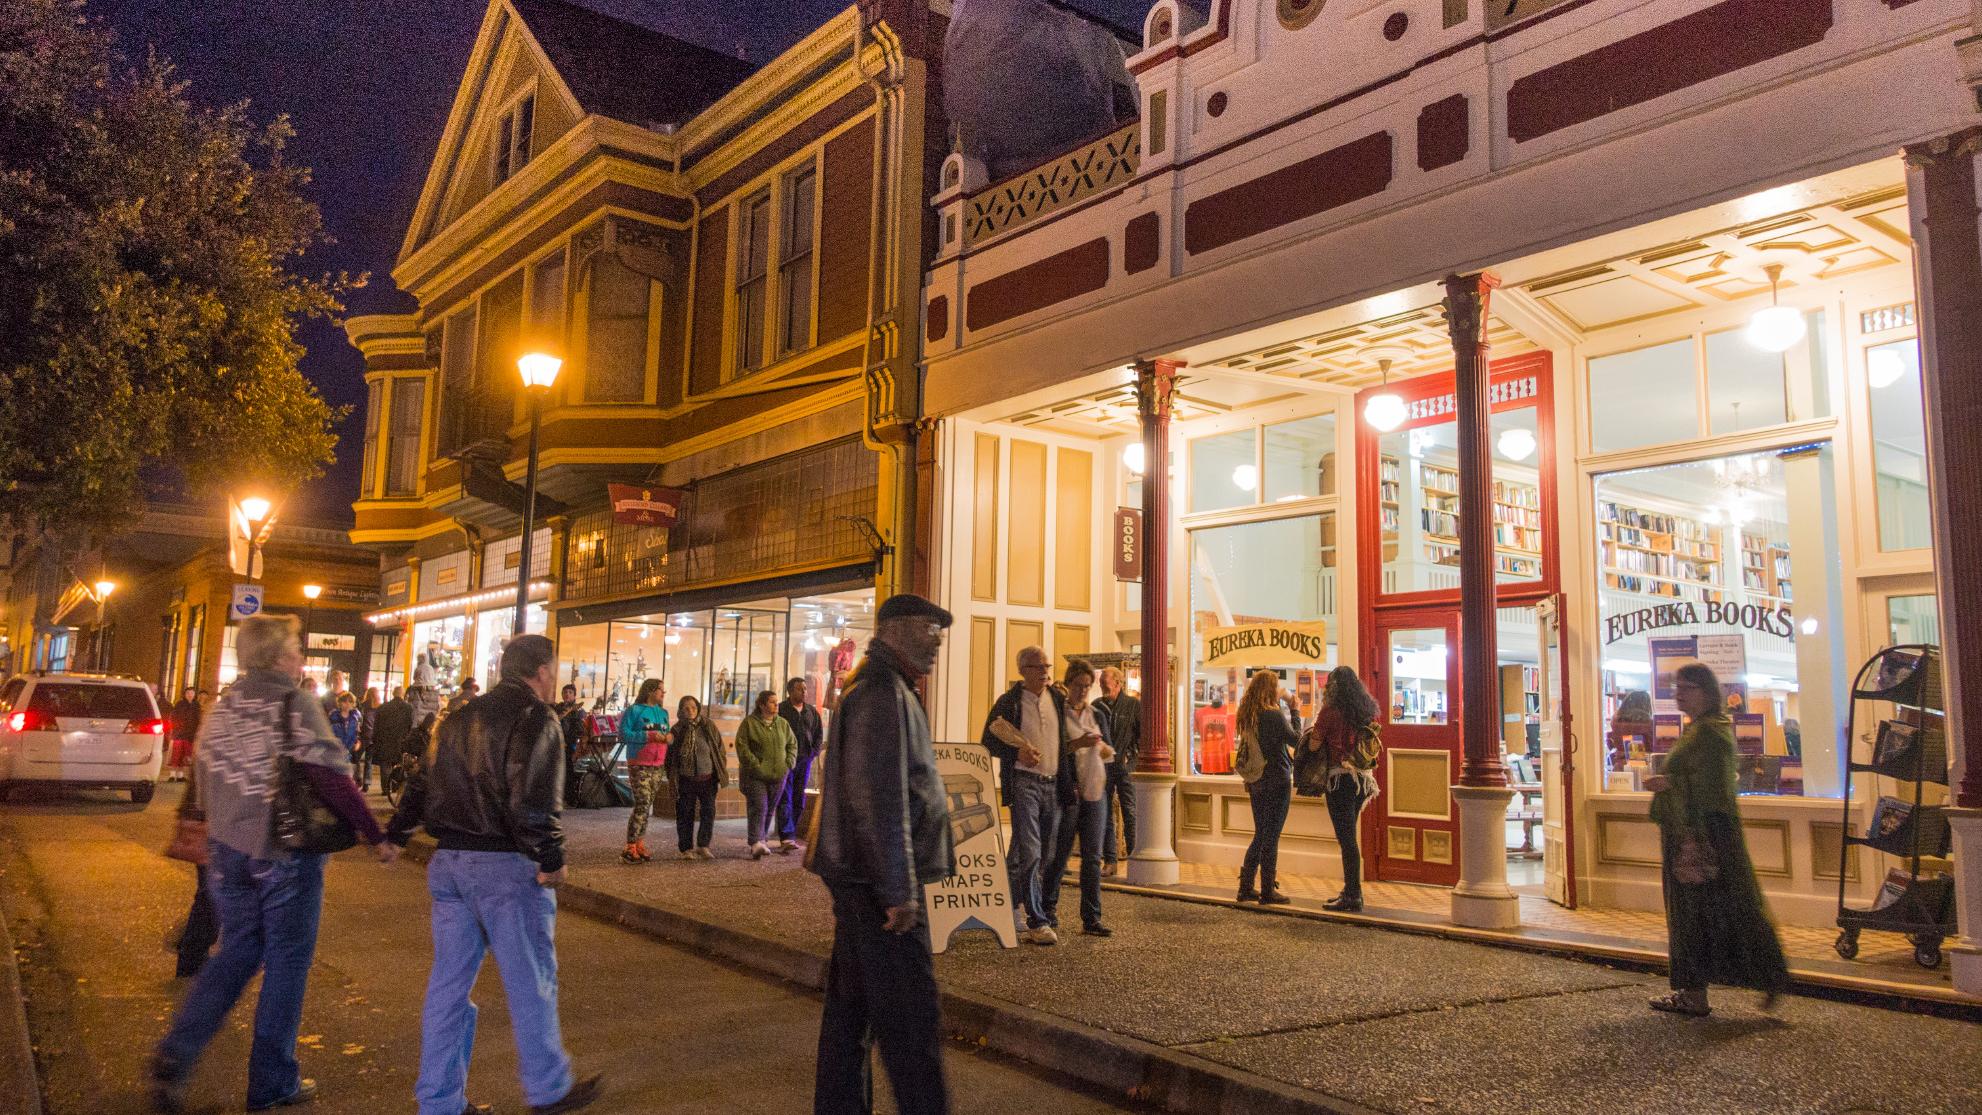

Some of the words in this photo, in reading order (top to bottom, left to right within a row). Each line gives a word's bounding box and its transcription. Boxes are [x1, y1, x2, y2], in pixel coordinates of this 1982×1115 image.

[1123, 516, 1134, 562] BOOKS
[1605, 601, 1699, 645] EUREKA
[1706, 601, 1793, 638] BOOKS
[1208, 629, 1266, 661] EUREKA
[1270, 629, 1321, 659] BOOKS
[955, 748, 989, 772] BOOKS
[958, 854, 997, 868] OKS
[941, 873, 993, 888] MAPS
[933, 892, 1005, 909] PRINTS
